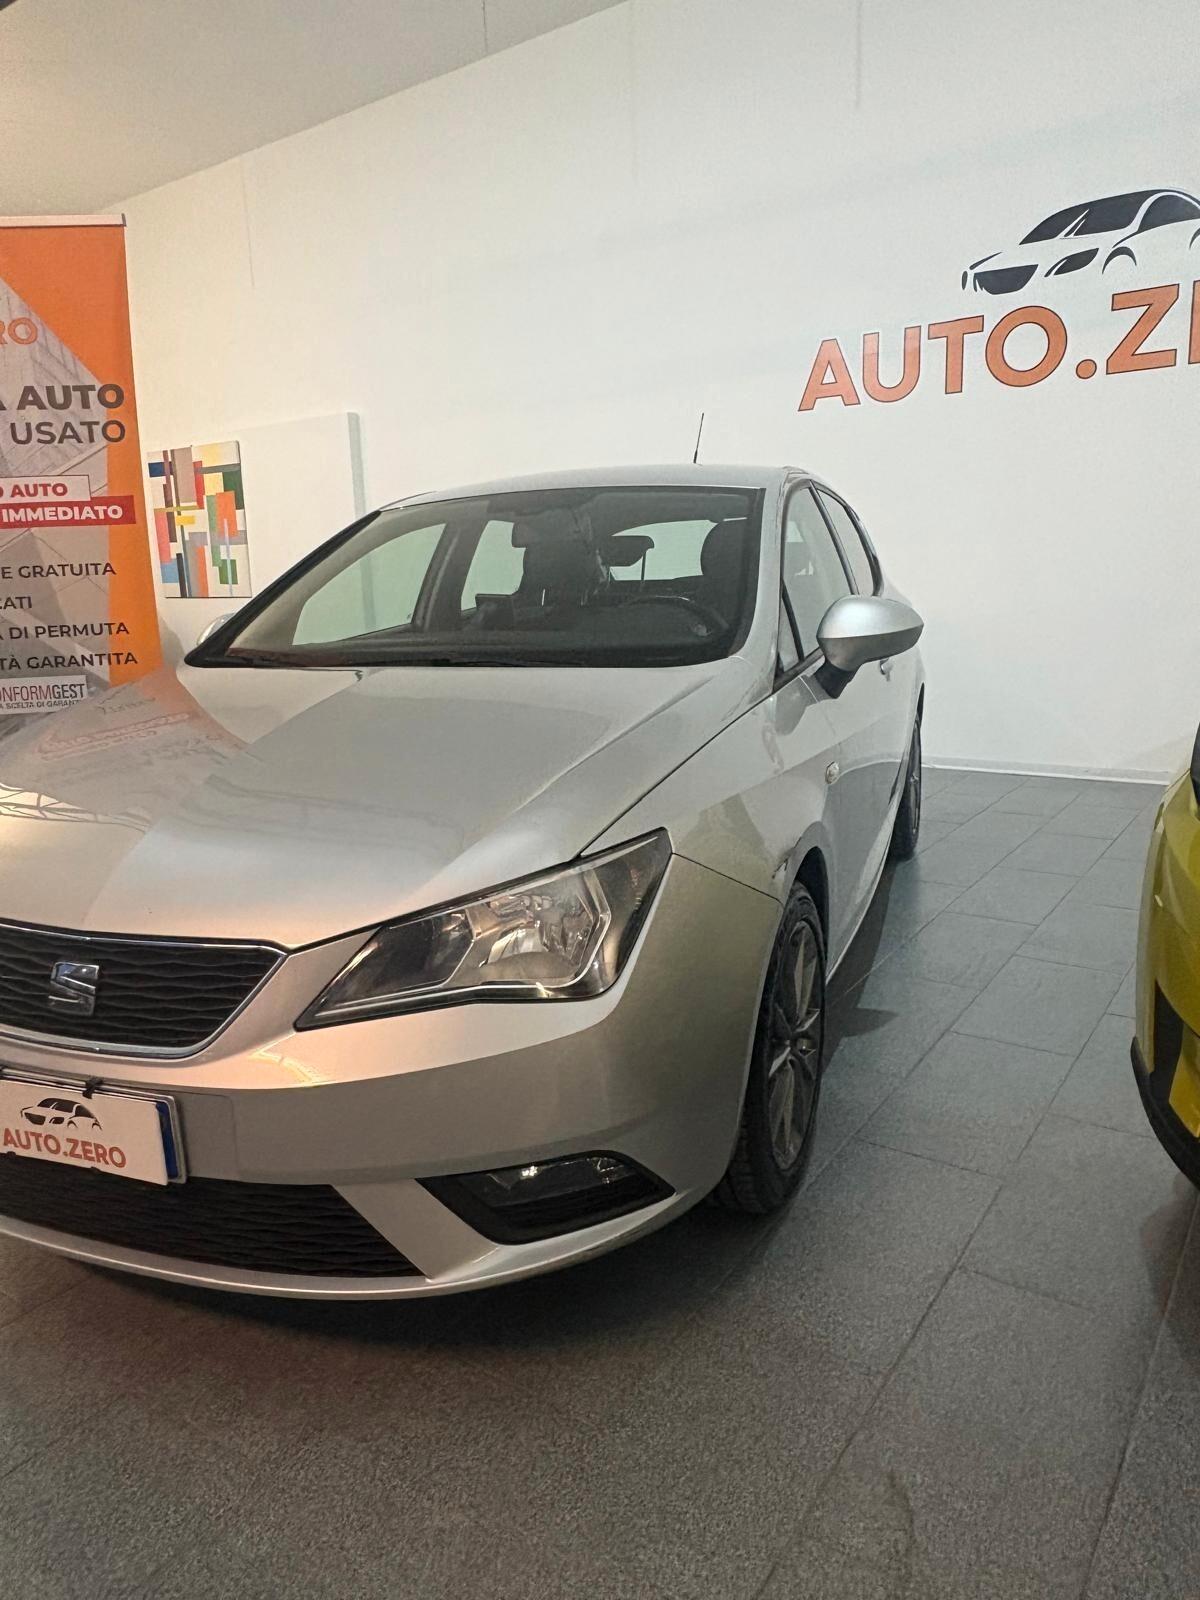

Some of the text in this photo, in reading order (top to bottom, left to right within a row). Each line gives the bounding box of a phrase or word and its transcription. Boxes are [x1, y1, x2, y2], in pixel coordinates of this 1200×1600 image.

[798, 280, 1200, 411] AUTO.Z
[16, 383, 125, 410] AUTO
[10, 419, 126, 444] USATO
[10, 482, 68, 498] AUTO
[2, 505, 123, 522] IMMEDIATO
[18, 562, 116, 578] GRATUITA
[0, 596, 32, 610] ATI
[9, 626, 29, 640] DI
[35, 622, 130, 638] PERMUTA
[27, 652, 138, 669] GARANTITA
[0, 683, 85, 702] NFORMGEST
[3, 1128, 127, 1169] AUTO.ZERO
